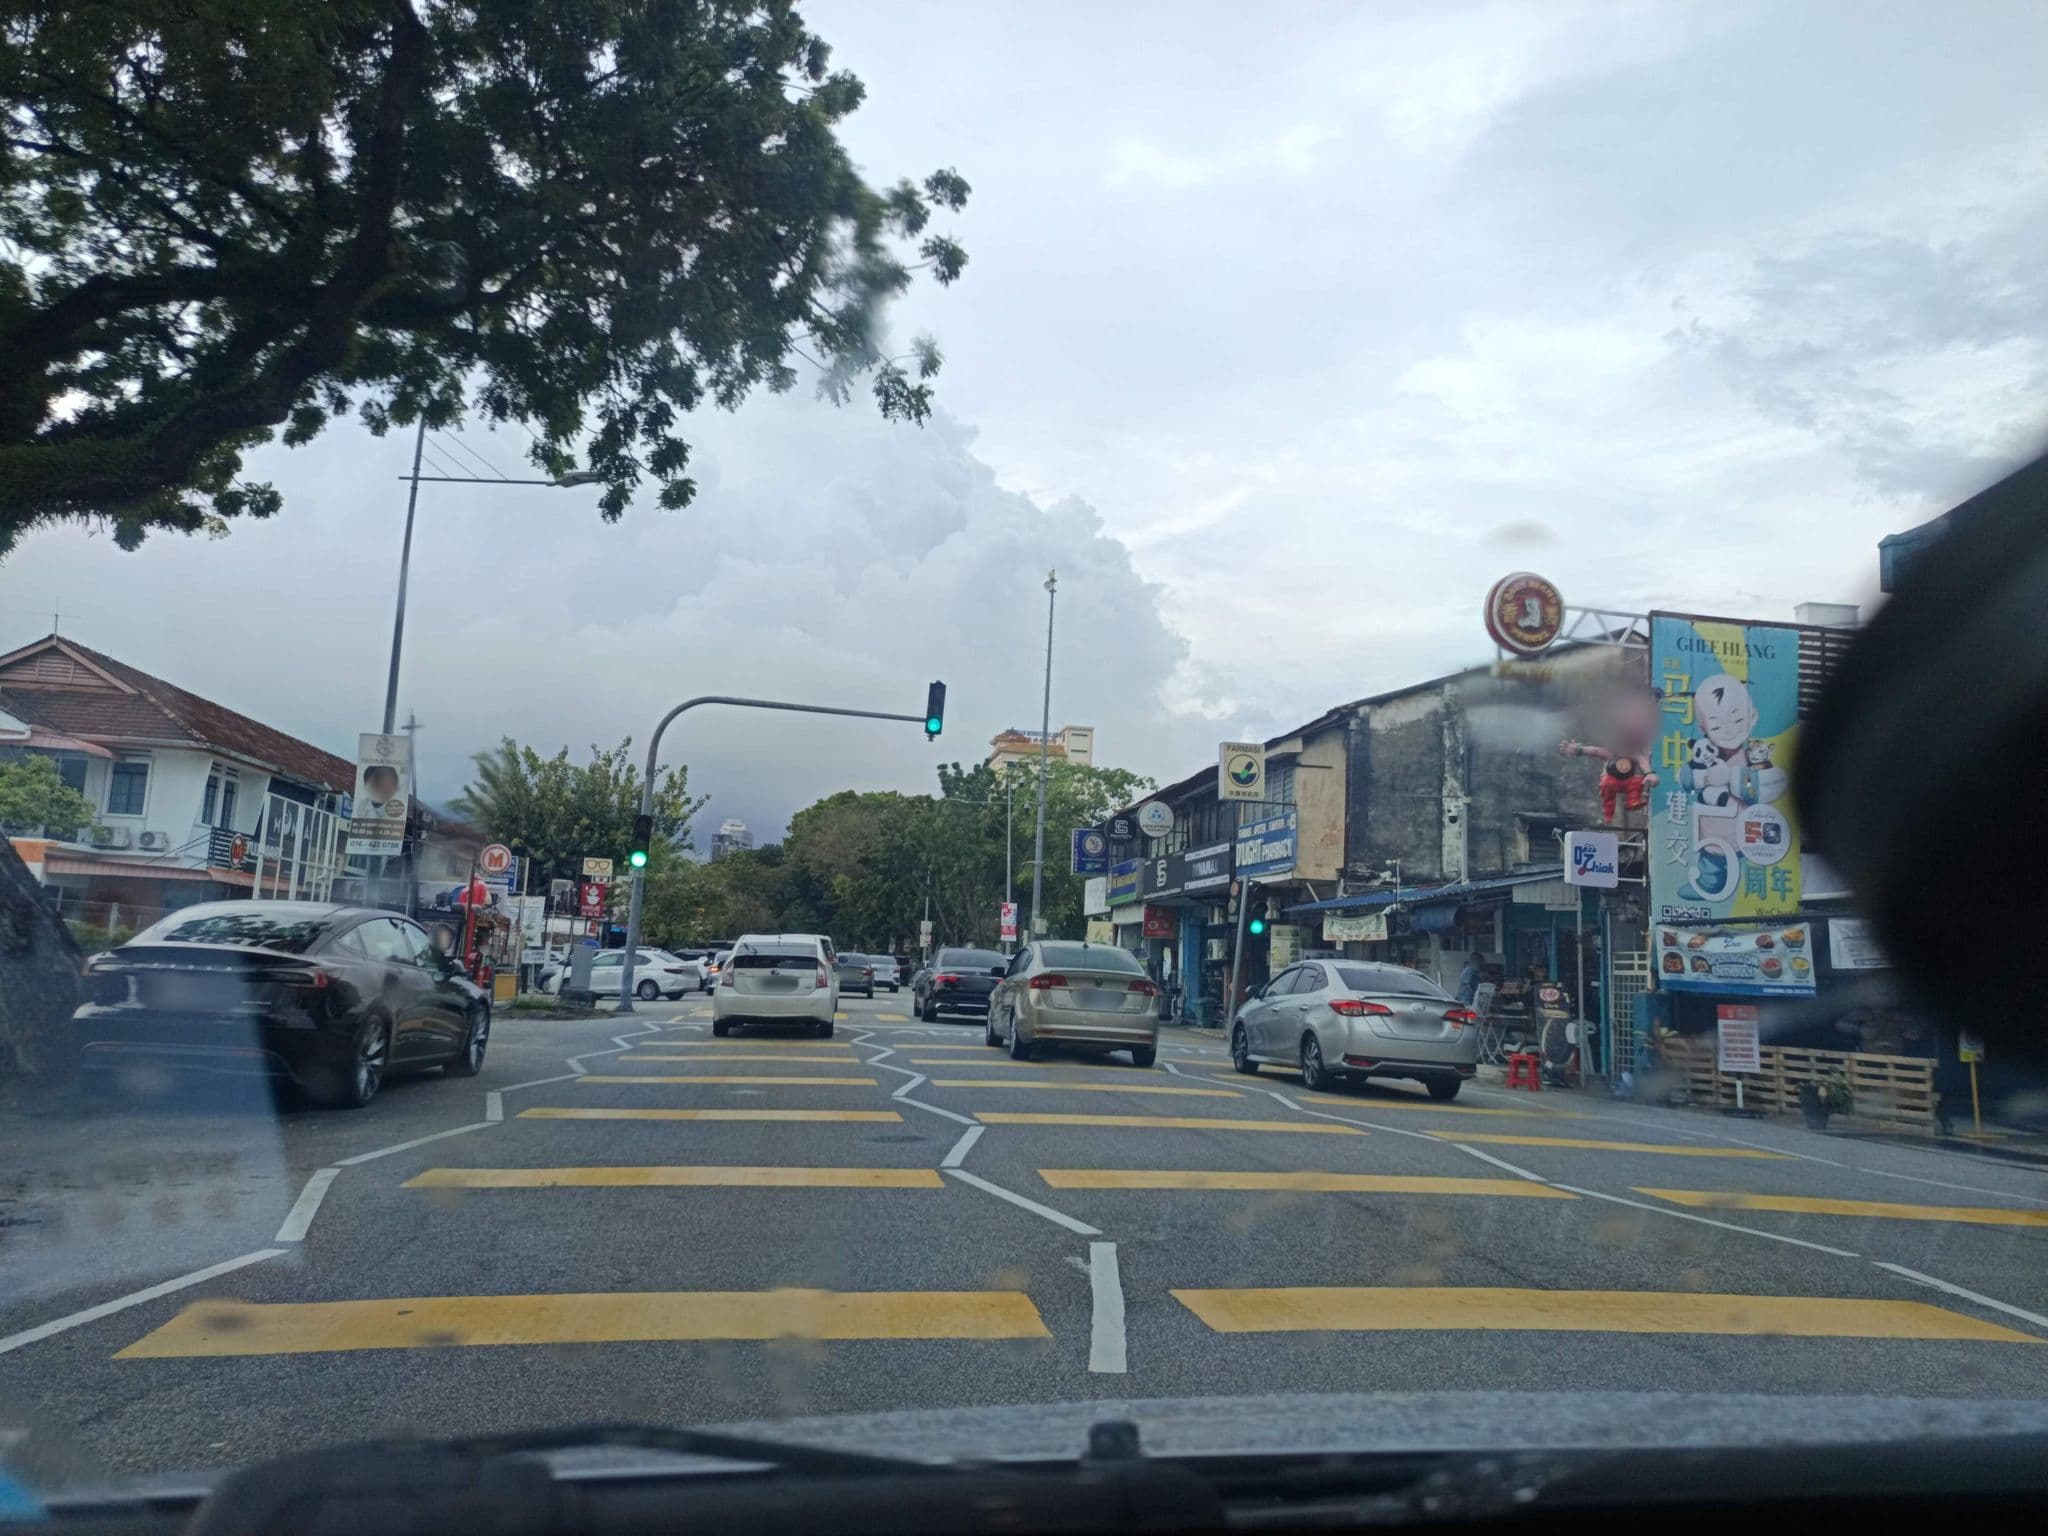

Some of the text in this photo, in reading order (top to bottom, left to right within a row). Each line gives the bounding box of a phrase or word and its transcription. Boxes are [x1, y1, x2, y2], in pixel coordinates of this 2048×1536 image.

[1676, 637, 1720, 655] GHEE
[1722, 641, 1776, 660] HIANG
[1227, 744, 1261, 753] FARMASI
